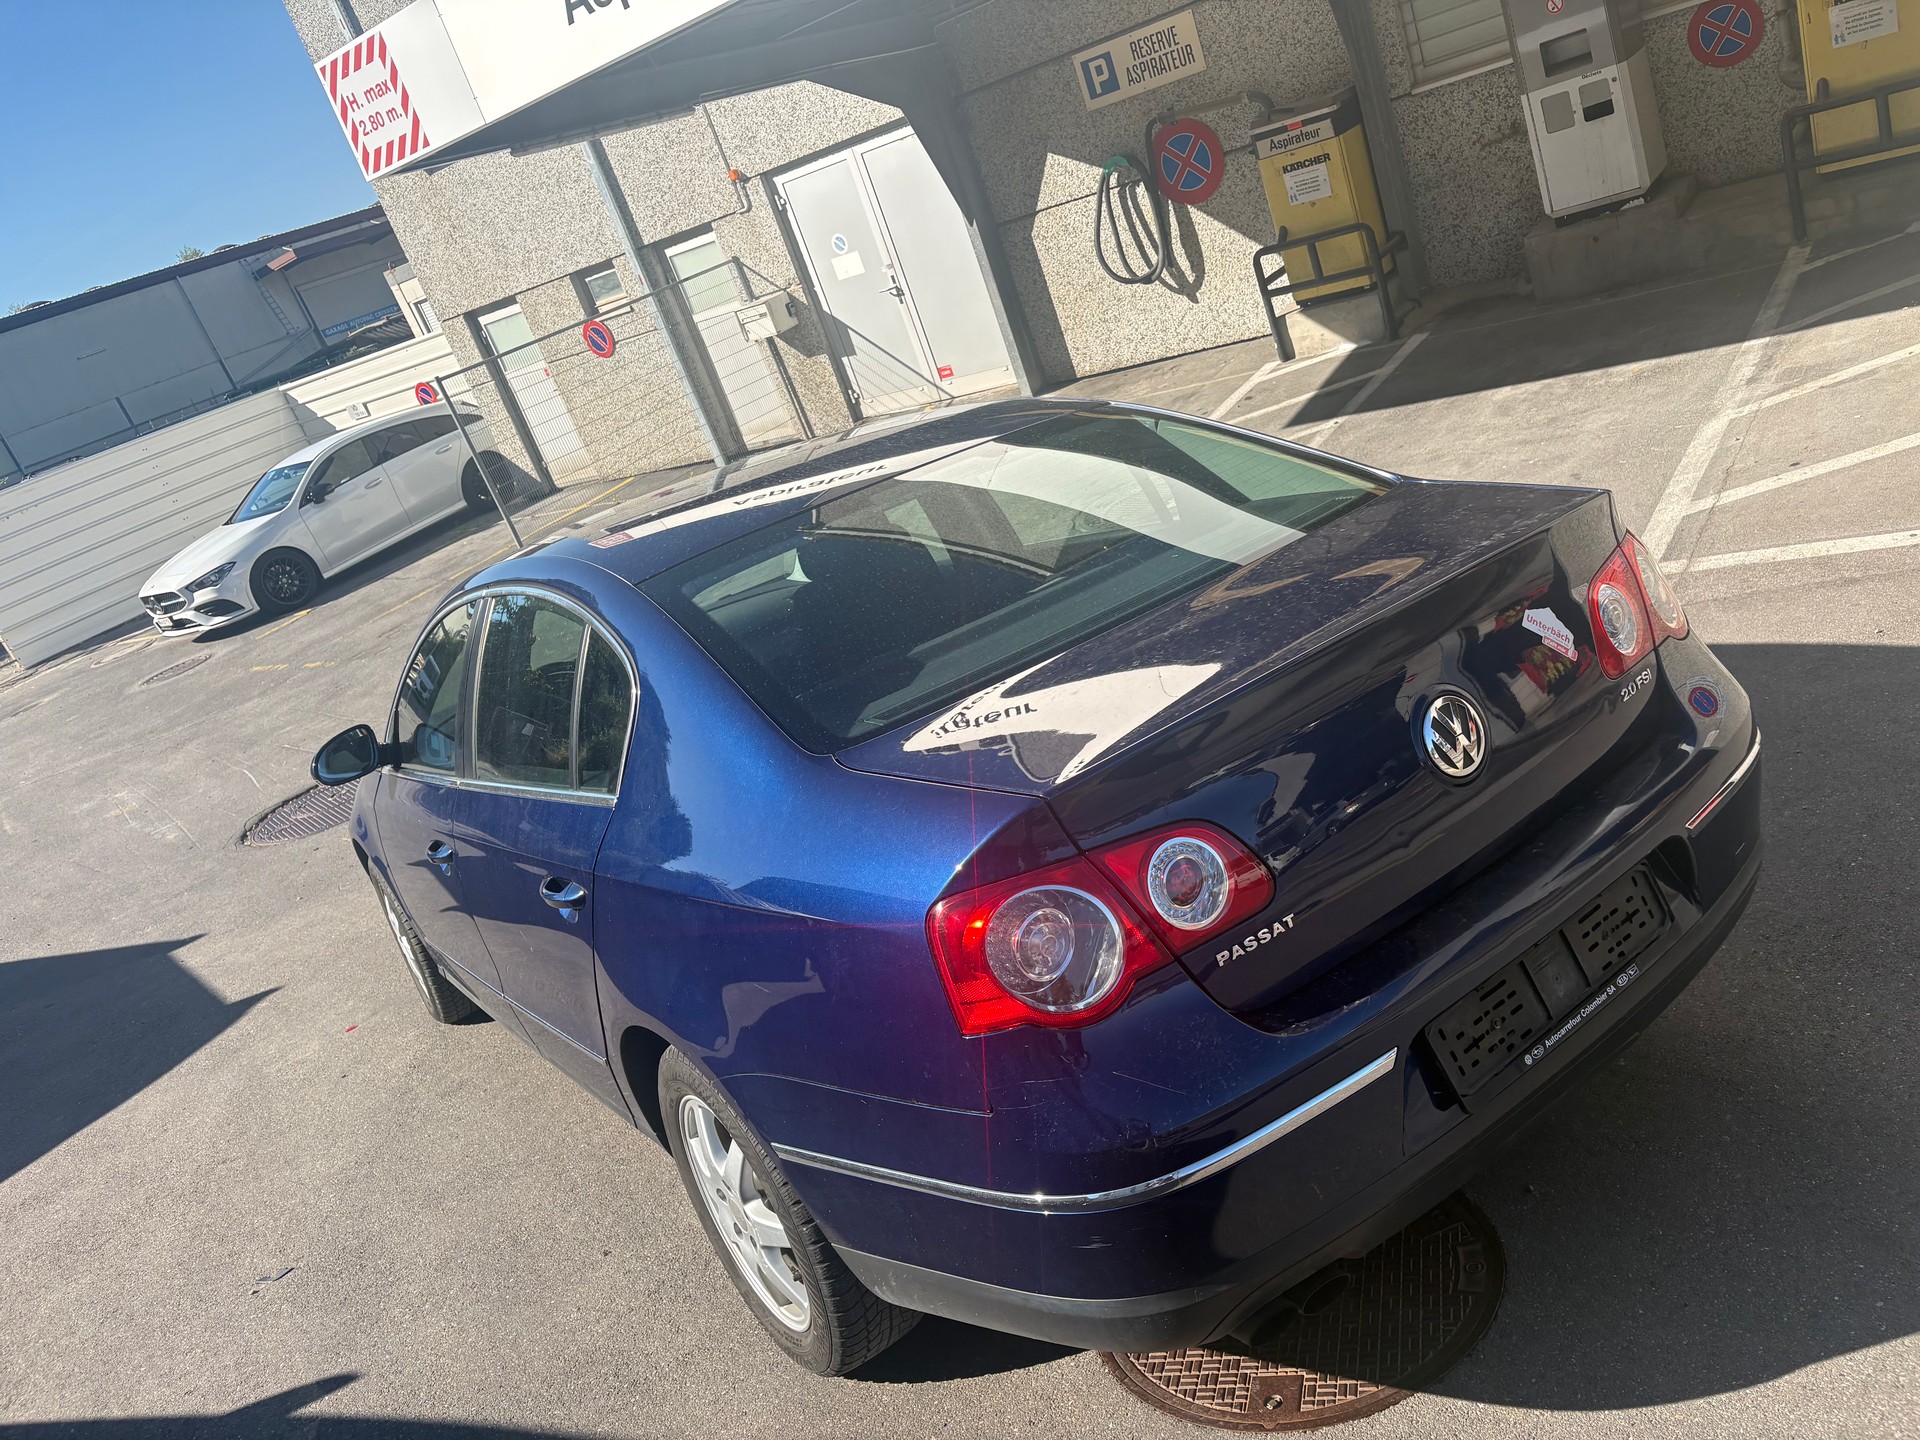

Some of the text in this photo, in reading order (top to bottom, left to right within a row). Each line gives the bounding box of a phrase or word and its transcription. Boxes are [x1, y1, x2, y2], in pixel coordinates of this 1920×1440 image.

[1129, 25, 1180, 61] RESERVE
[1088, 58, 1109, 95] P
[1126, 43, 1196, 87] ASPIRATEUR
[346, 79, 392, 113] H. max
[385, 107, 403, 123] m.
[1269, 127, 1321, 152] Aspirateur
[1526, 613, 1571, 645] Unterbäch
[1635, 668, 1652, 690] FSI
[1215, 912, 1295, 968] PASSAT
[1544, 1014, 1582, 1049] Autocarrefour
[1580, 991, 1608, 1018] Colombier
[1606, 984, 1617, 996] SA
